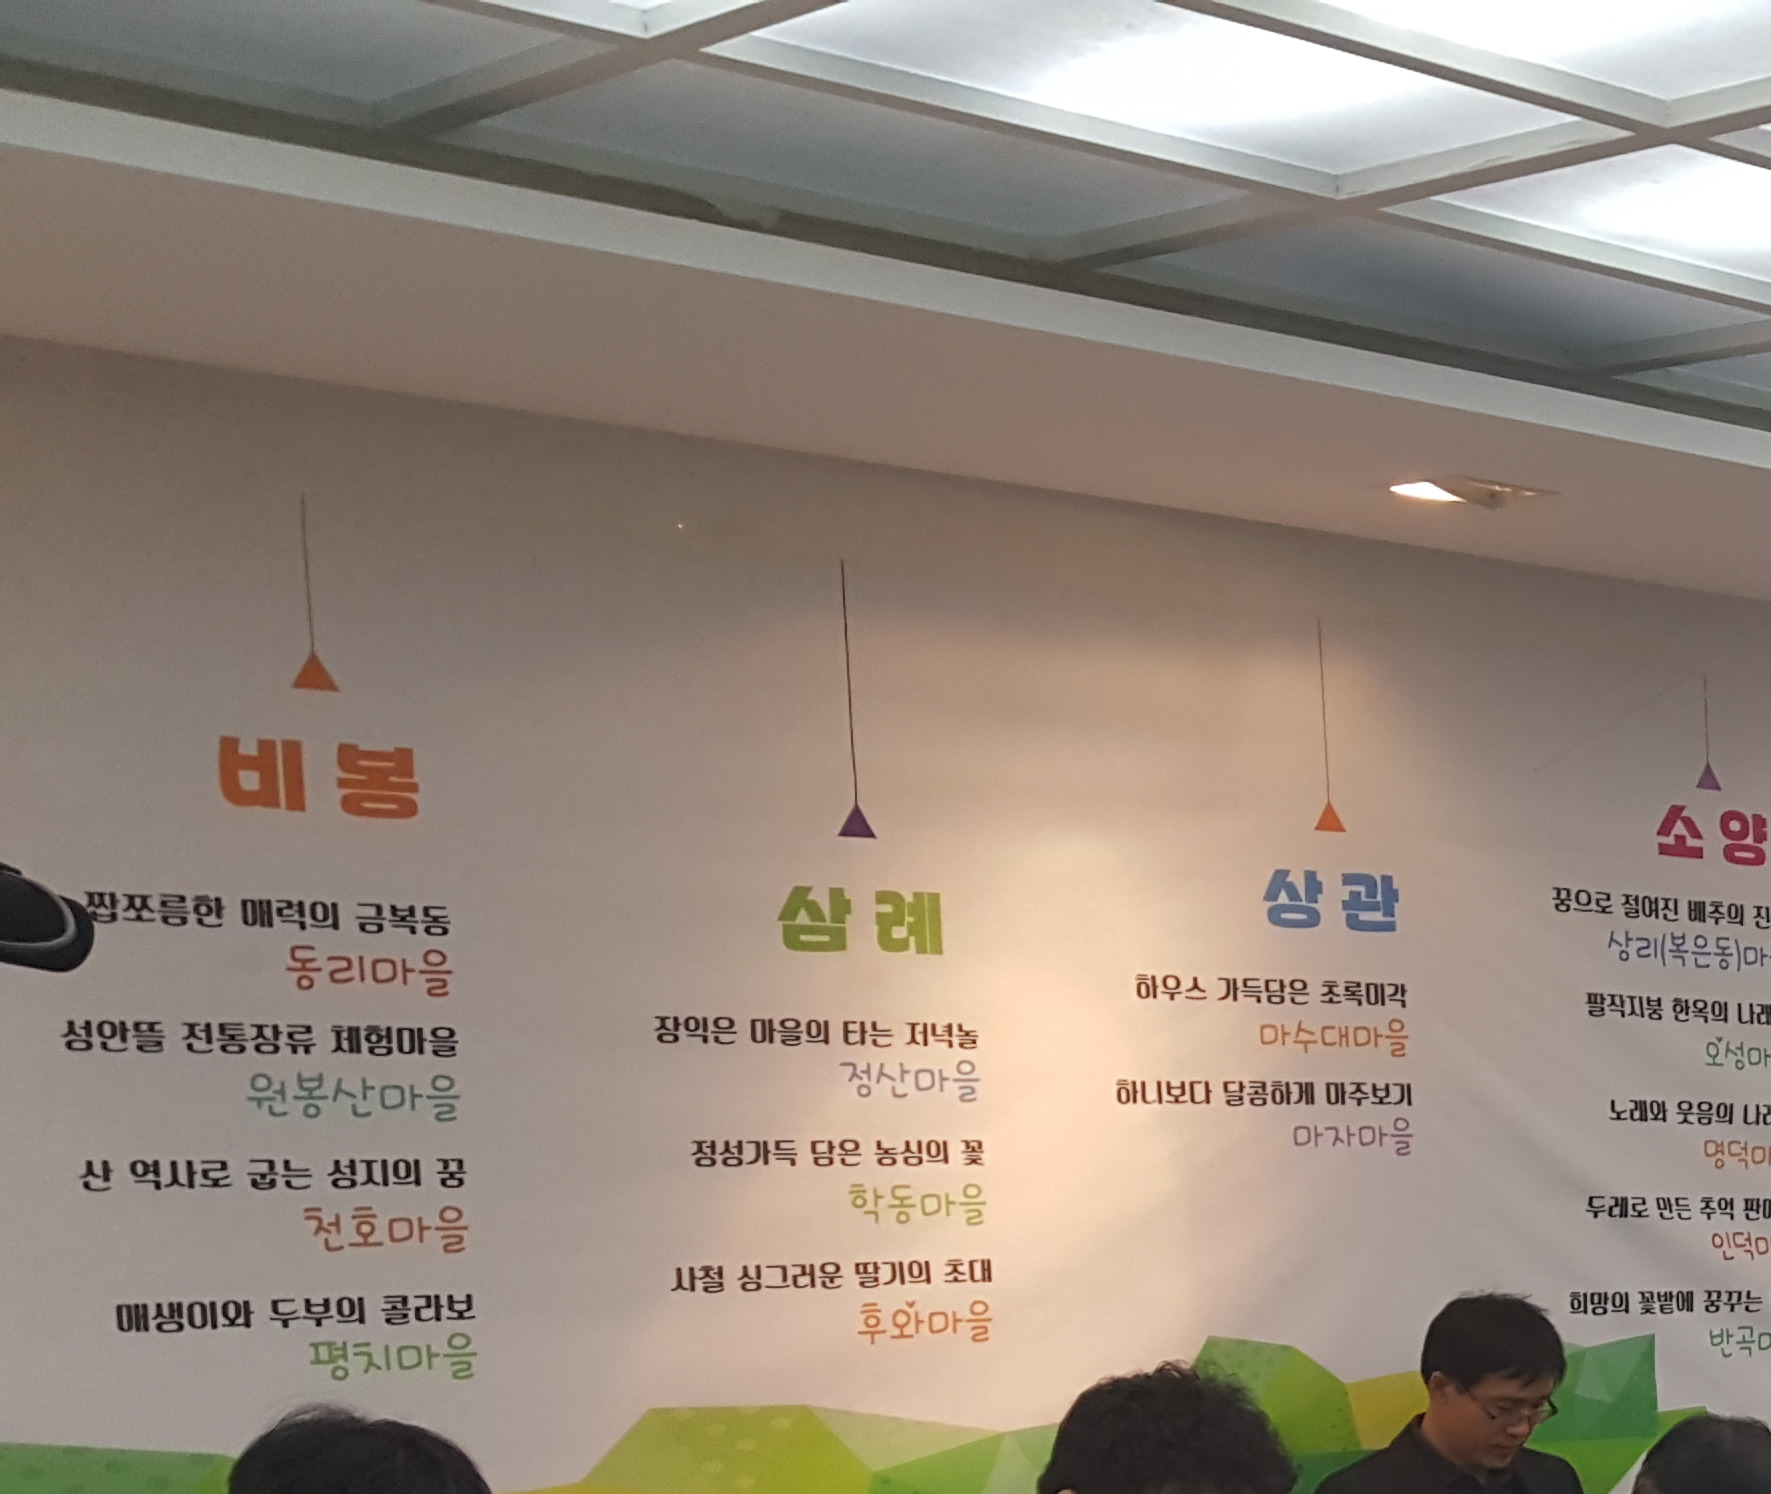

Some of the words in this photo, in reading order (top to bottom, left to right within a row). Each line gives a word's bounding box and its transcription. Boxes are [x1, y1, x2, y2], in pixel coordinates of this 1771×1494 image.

[219, 736, 419, 819] 비봉
[1656, 805, 1767, 866] 소양
[241, 899, 339, 931] 매력의
[356, 903, 450, 936] 금복동
[1263, 869, 1399, 932] 상관
[1552, 887, 1613, 914] 꿈으로
[1622, 894, 1678, 922] 절여진
[1688, 900, 1744, 926] 배추의
[778, 886, 944, 955] 삼례
[286, 945, 453, 997] 동리마을
[1136, 974, 1207, 1001] 하우스
[1218, 978, 1309, 1005] 가득담은
[1320, 981, 1407, 1008] 초록미각
[1586, 993, 1663, 1020] 팔작지붕
[1672, 998, 1728, 1023] 한옥의
[61, 1020, 165, 1053] 성안뜰
[182, 1022, 316, 1054] 전통장류
[331, 1025, 458, 1058] 체험마을
[655, 1016, 737, 1045] 장익은
[750, 1018, 829, 1046] 마을의
[843, 1021, 893, 1048] 타는
[906, 1023, 978, 1049] 저녁놀
[1260, 1018, 1409, 1057] 마수대마을
[247, 1072, 460, 1122] 원봉산마을
[840, 1060, 980, 1103] 정산마을
[1117, 1080, 1212, 1104] 하니보다
[1223, 1081, 1315, 1106] 달콤하게
[1325, 1082, 1412, 1106] 마주보기
[1610, 1100, 1667, 1122] 노래와
[1677, 1101, 1733, 1125] 웃음의
[691, 1140, 797, 1167] 정성가득
[875, 1140, 949, 1166] 농심의
[961, 1140, 984, 1165] 꽃
[1293, 1117, 1413, 1156] 마자마을
[80, 1160, 113, 1192] 산
[130, 1160, 232, 1190] 역사로
[247, 1159, 312, 1190] 굽는
[328, 1159, 421, 1189] 성지의
[437, 1159, 467, 1188] 꿈
[849, 1184, 987, 1226] 학동마을
[1586, 1196, 1649, 1219] 두레로
[1656, 1197, 1691, 1220] 만든
[1700, 1197, 1734, 1220] 추억
[304, 1206, 469, 1254] 천호마을
[671, 1266, 724, 1293] 사철
[738, 1262, 843, 1292] 싱그러운
[855, 1260, 931, 1288] 딸기의
[945, 1259, 992, 1283] 초대
[116, 1300, 254, 1333] 매생이와
[270, 1297, 365, 1328] 두부의
[381, 1294, 475, 1325] 콜라보
[1570, 1292, 1629, 1315] 희망의
[1638, 1291, 1693, 1315] 꽃밭에
[1704, 1290, 1762, 1313] 꿈꾸는
[308, 1332, 477, 1381] 평치마을
